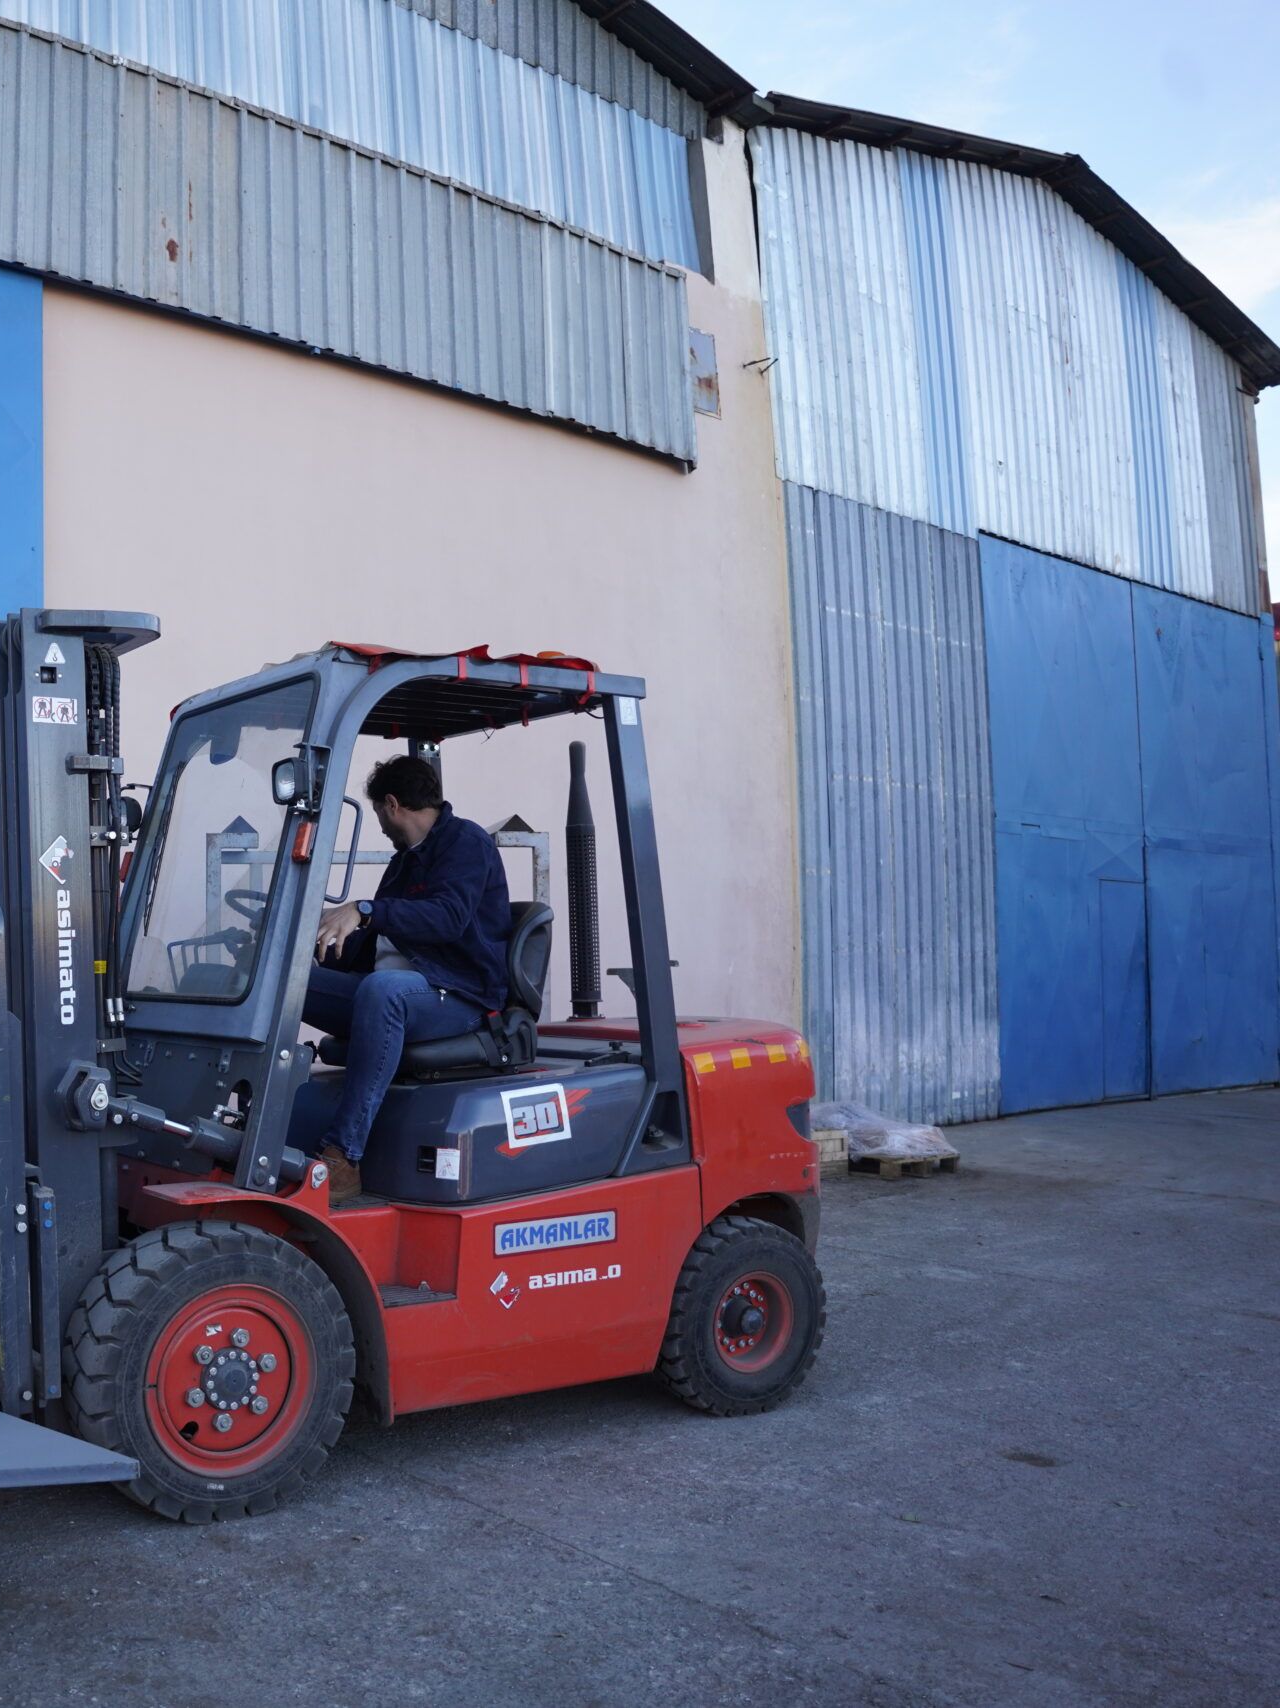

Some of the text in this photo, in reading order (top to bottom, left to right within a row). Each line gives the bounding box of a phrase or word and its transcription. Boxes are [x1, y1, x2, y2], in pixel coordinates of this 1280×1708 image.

[57, 889, 76, 1025] asimato
[512, 1101, 559, 1135] 30
[500, 1217, 610, 1250] AKMANLAR
[528, 1264, 621, 1289] asimao
